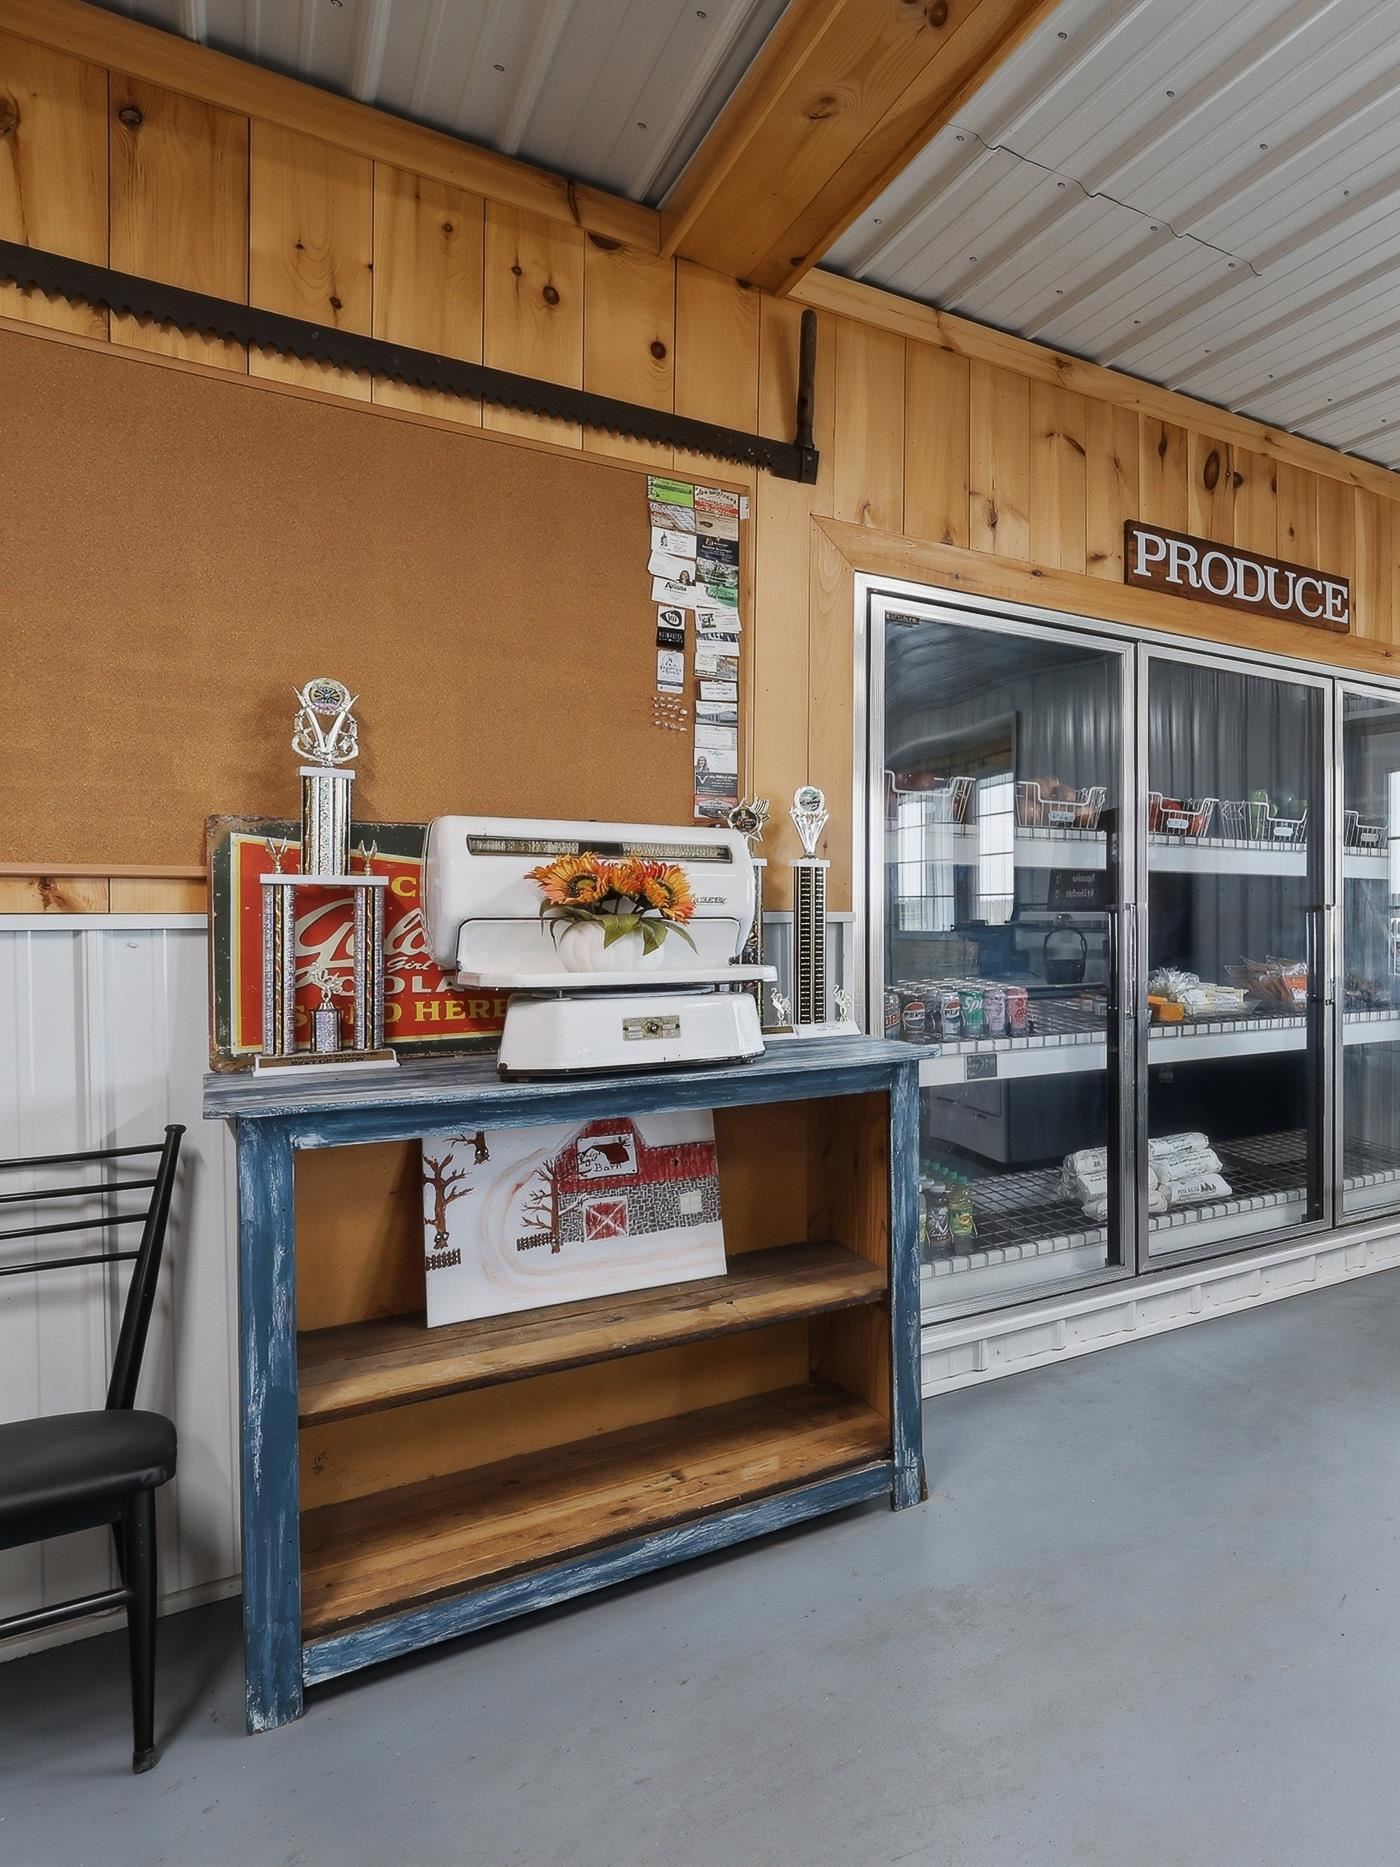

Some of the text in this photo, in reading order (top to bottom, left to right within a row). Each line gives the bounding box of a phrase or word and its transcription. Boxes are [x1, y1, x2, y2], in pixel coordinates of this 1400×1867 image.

[1133, 530, 1348, 624] PRODUCE
[387, 956, 432, 973] Girl
[415, 998, 507, 1022] HERE
